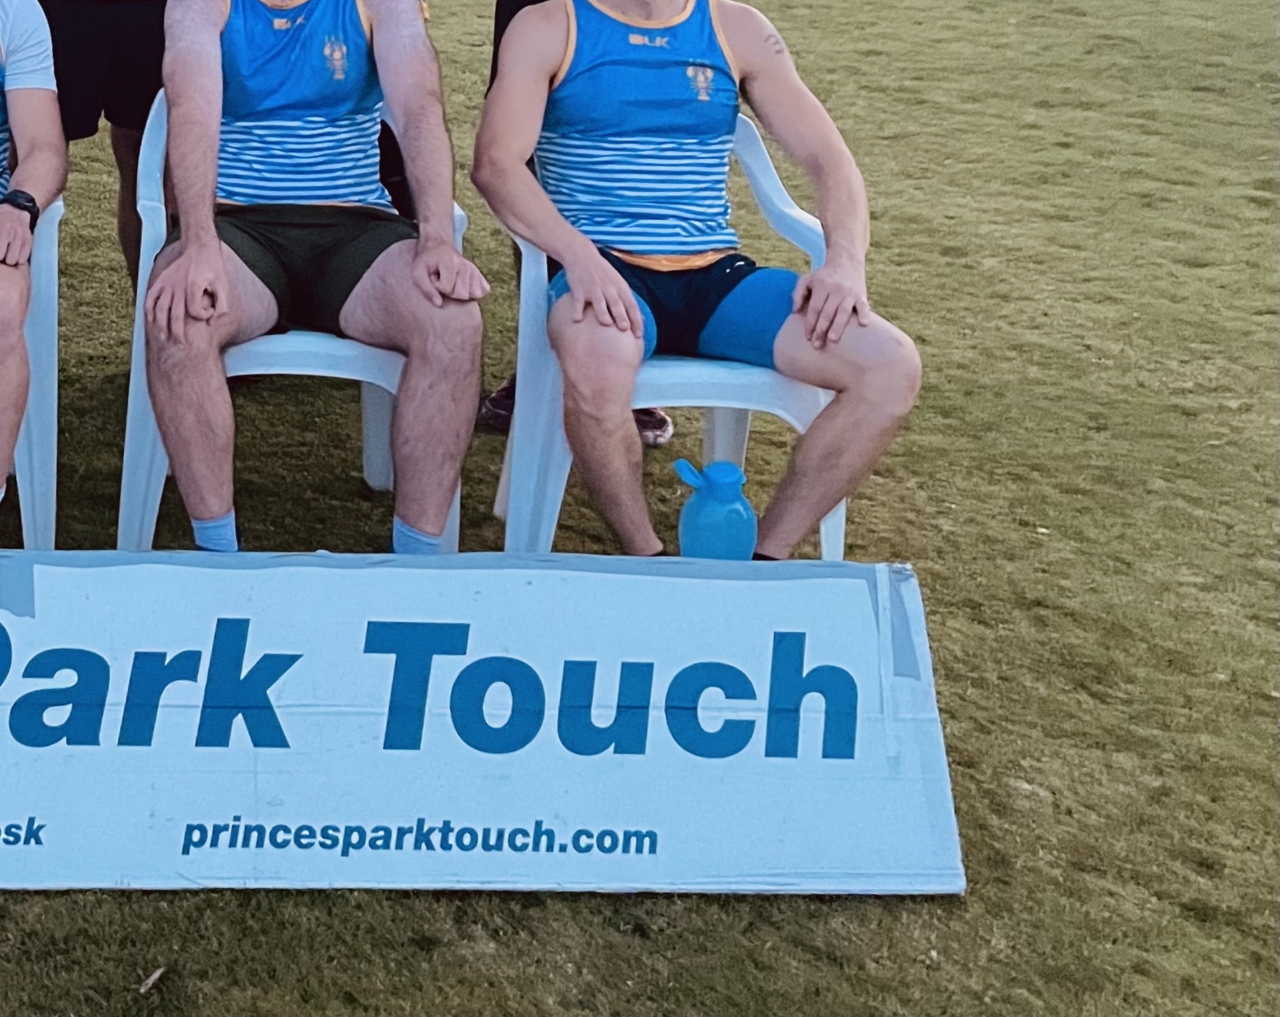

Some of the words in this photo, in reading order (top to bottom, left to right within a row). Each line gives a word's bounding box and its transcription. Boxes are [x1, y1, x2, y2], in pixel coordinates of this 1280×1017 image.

[628, 34, 670, 49] BLK
[363, 620, 859, 760] Touch
[181, 815, 659, 858] princesparktouch.com
